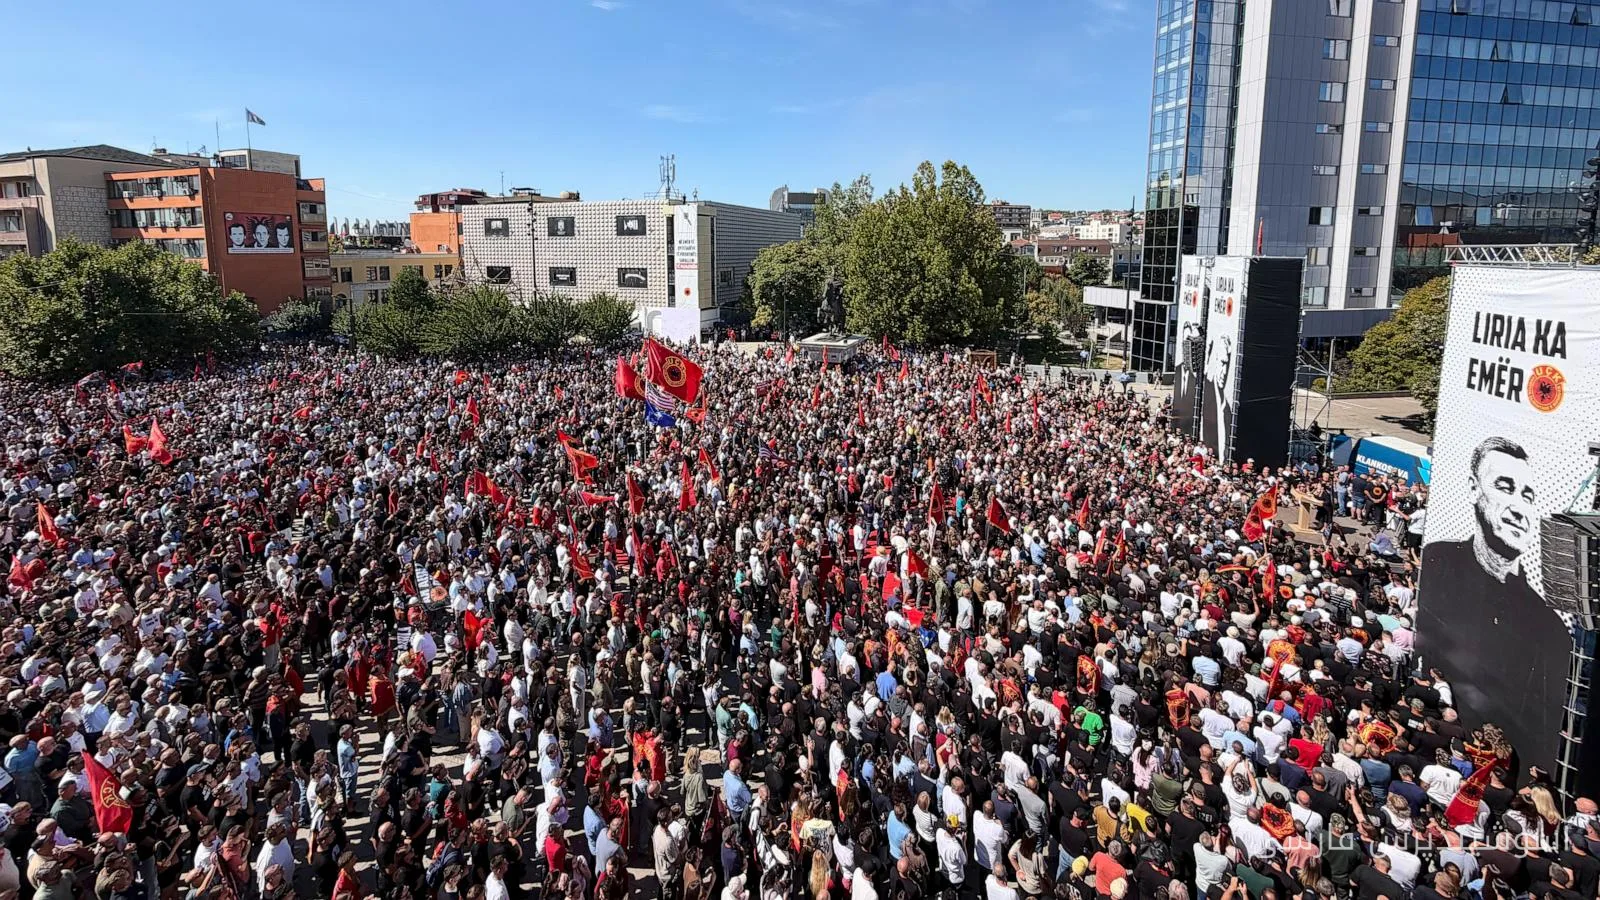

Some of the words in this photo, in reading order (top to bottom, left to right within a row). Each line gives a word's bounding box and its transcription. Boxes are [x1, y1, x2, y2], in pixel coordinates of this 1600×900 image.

[1472, 311, 1526, 352] LIRIA
[1533, 319, 1567, 359] KA
[1466, 356, 1524, 403] EMËR
